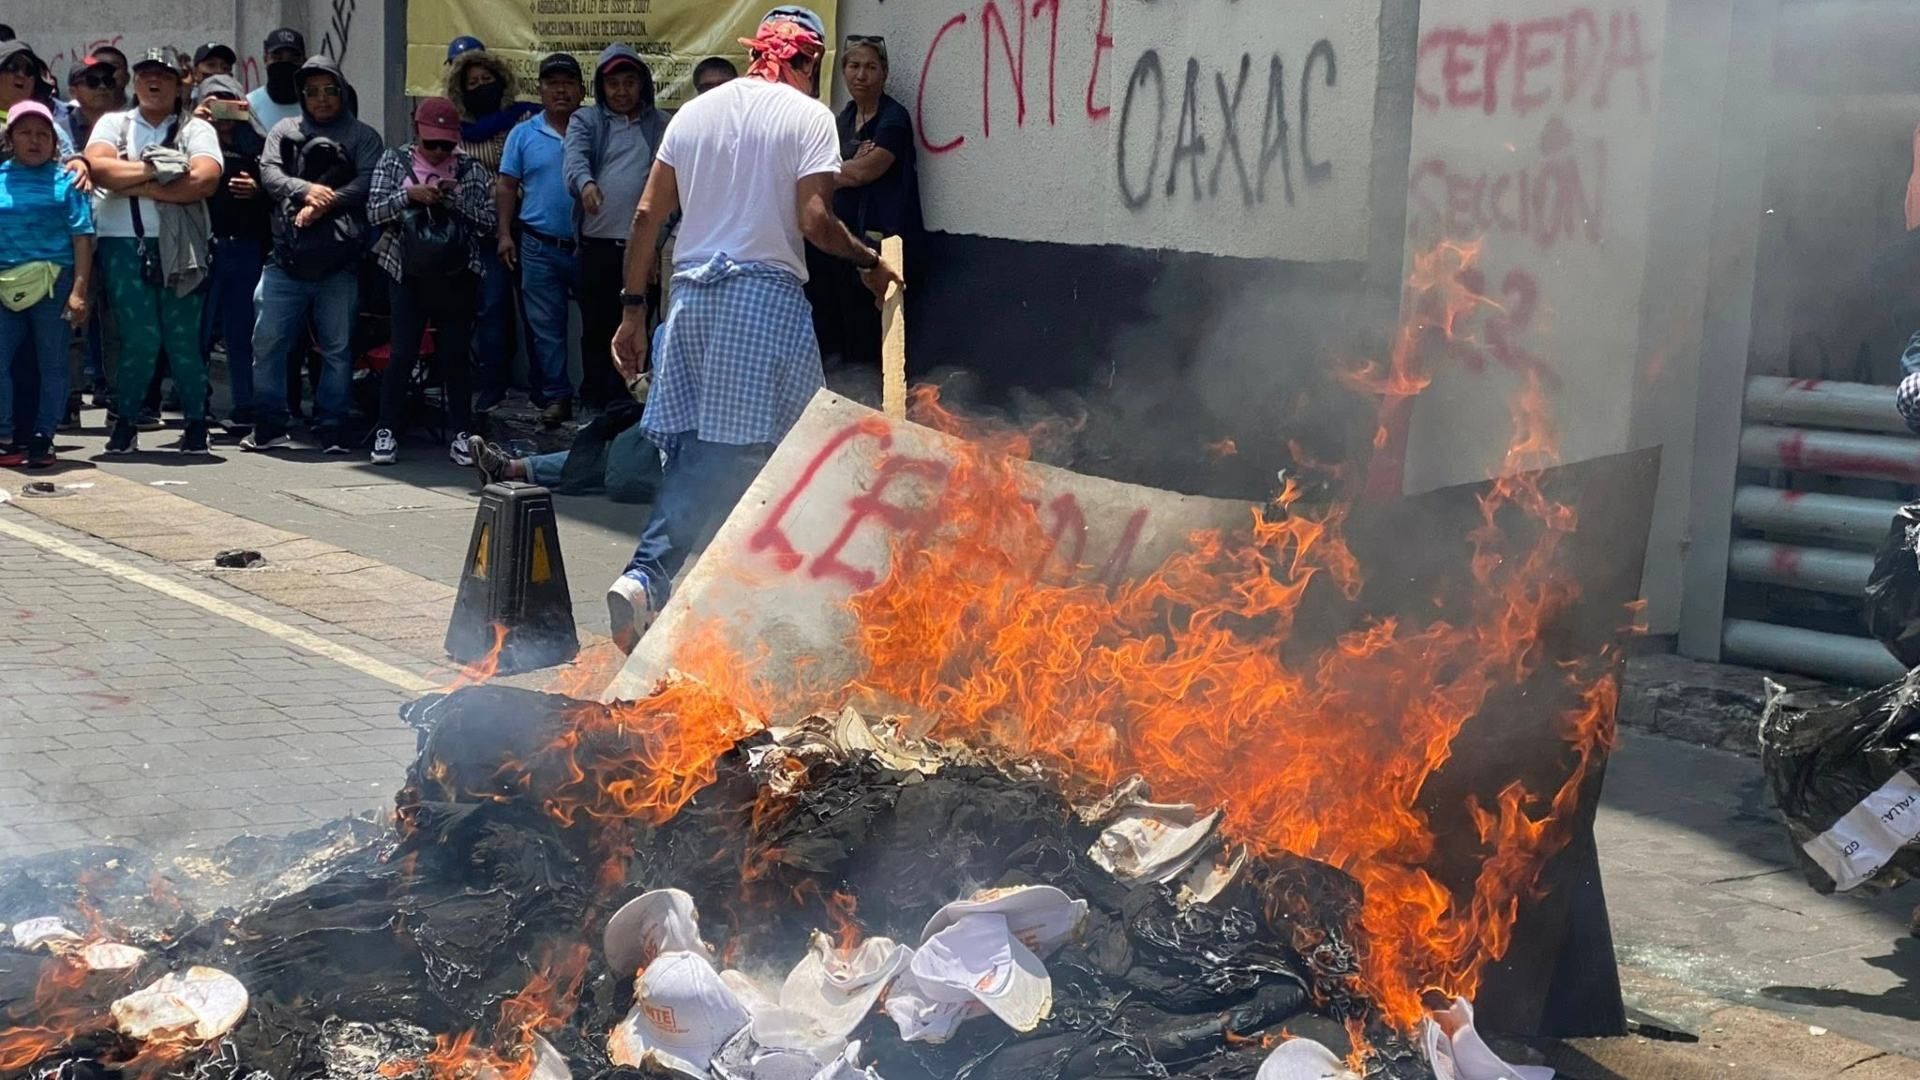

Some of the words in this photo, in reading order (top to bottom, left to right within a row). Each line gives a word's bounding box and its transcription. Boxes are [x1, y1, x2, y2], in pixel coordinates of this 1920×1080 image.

[917, 0, 1113, 154] CNTE
[1117, 38, 1336, 213] OAXAC
[1417, 8, 1655, 117] CEPEDA
[1881, 795, 1917, 823] TALLA:
